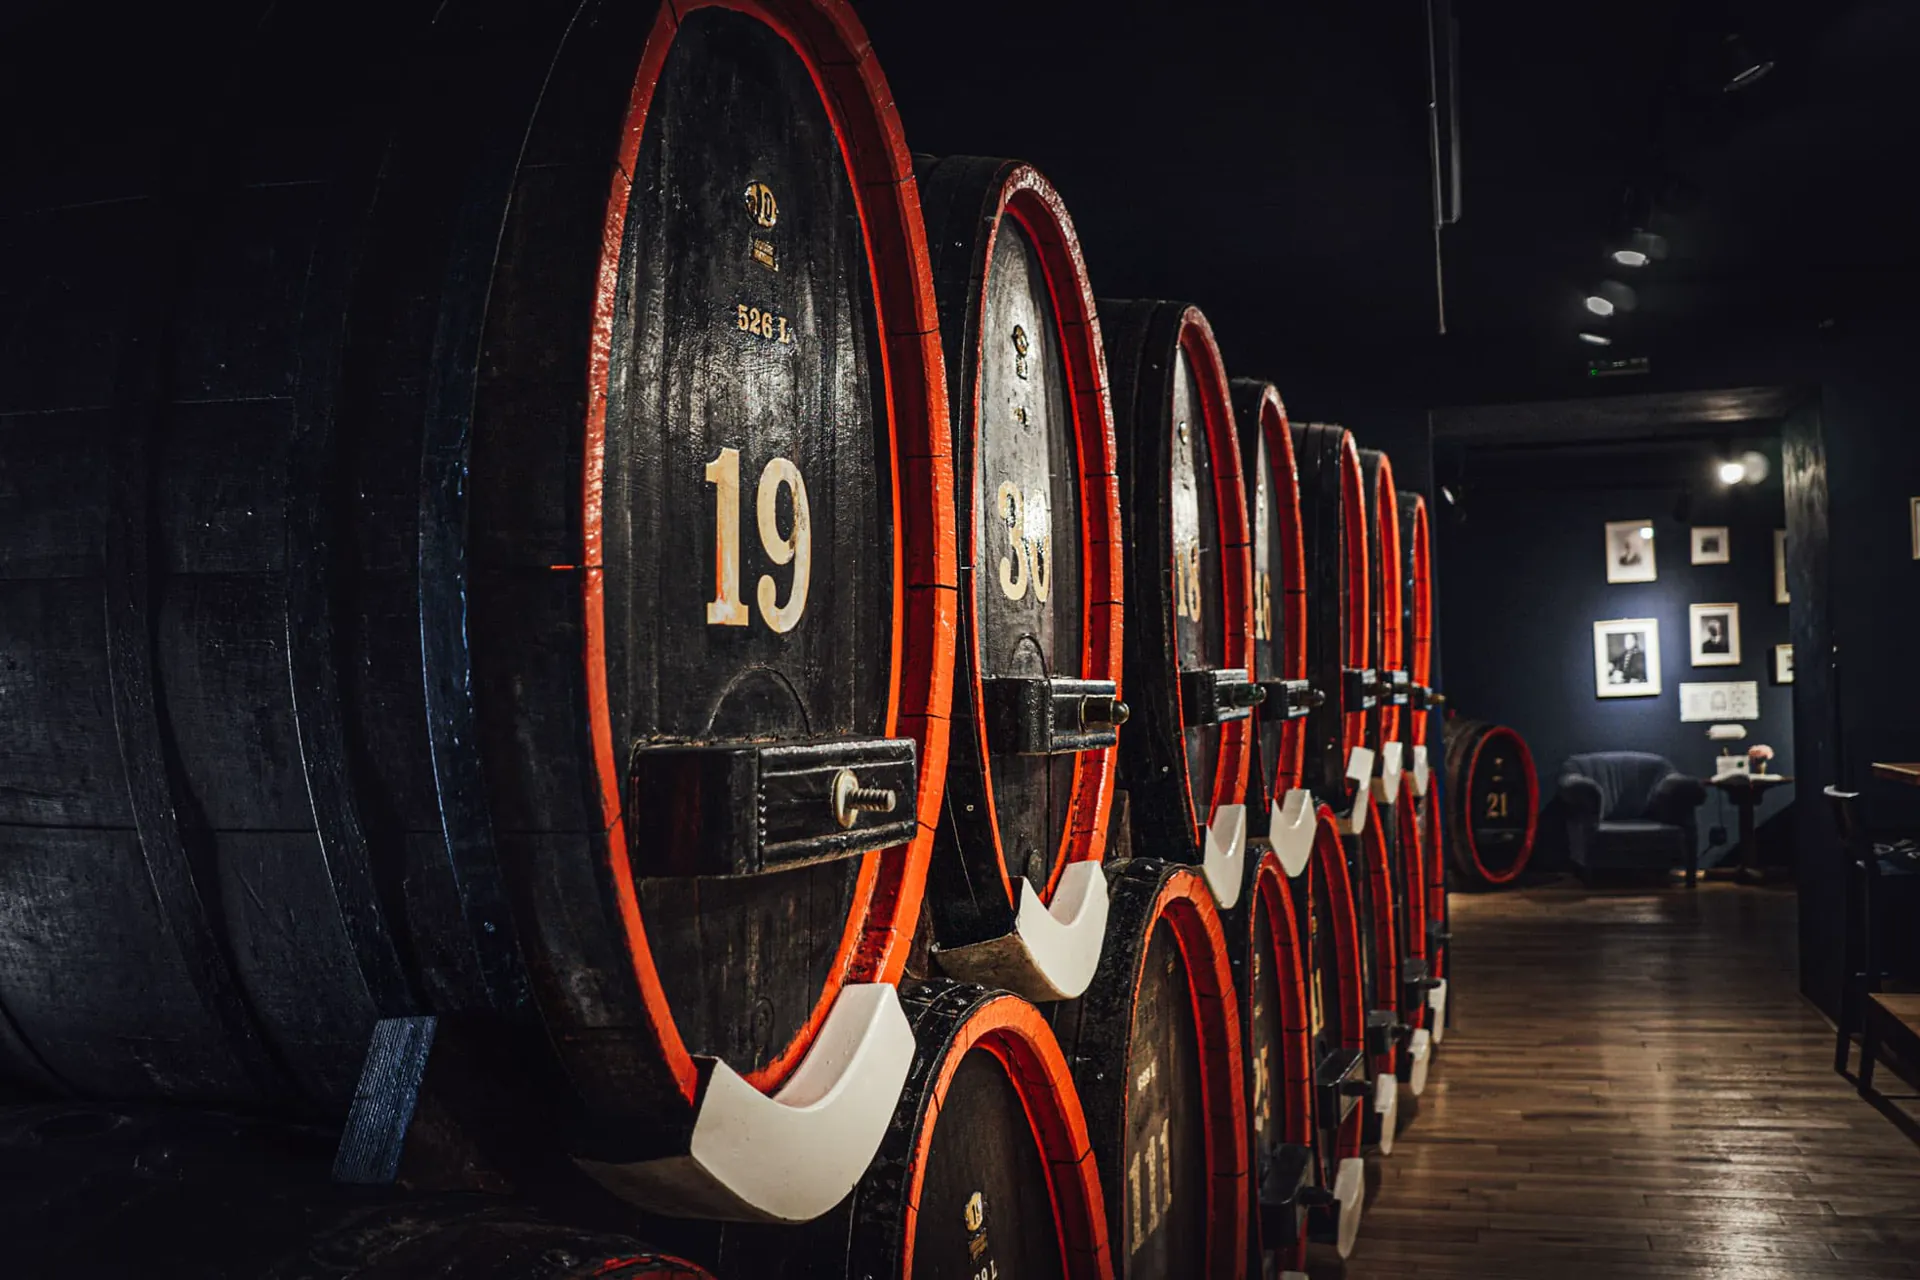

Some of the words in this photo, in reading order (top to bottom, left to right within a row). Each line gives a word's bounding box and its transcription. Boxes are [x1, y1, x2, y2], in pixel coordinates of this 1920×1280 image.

[738, 303, 773, 339] 526
[778, 316, 792, 344] L
[705, 447, 811, 634] 19
[998, 481, 1050, 602] 30
[1486, 792, 1507, 817] 21
[1129, 1118, 1172, 1256] 111
